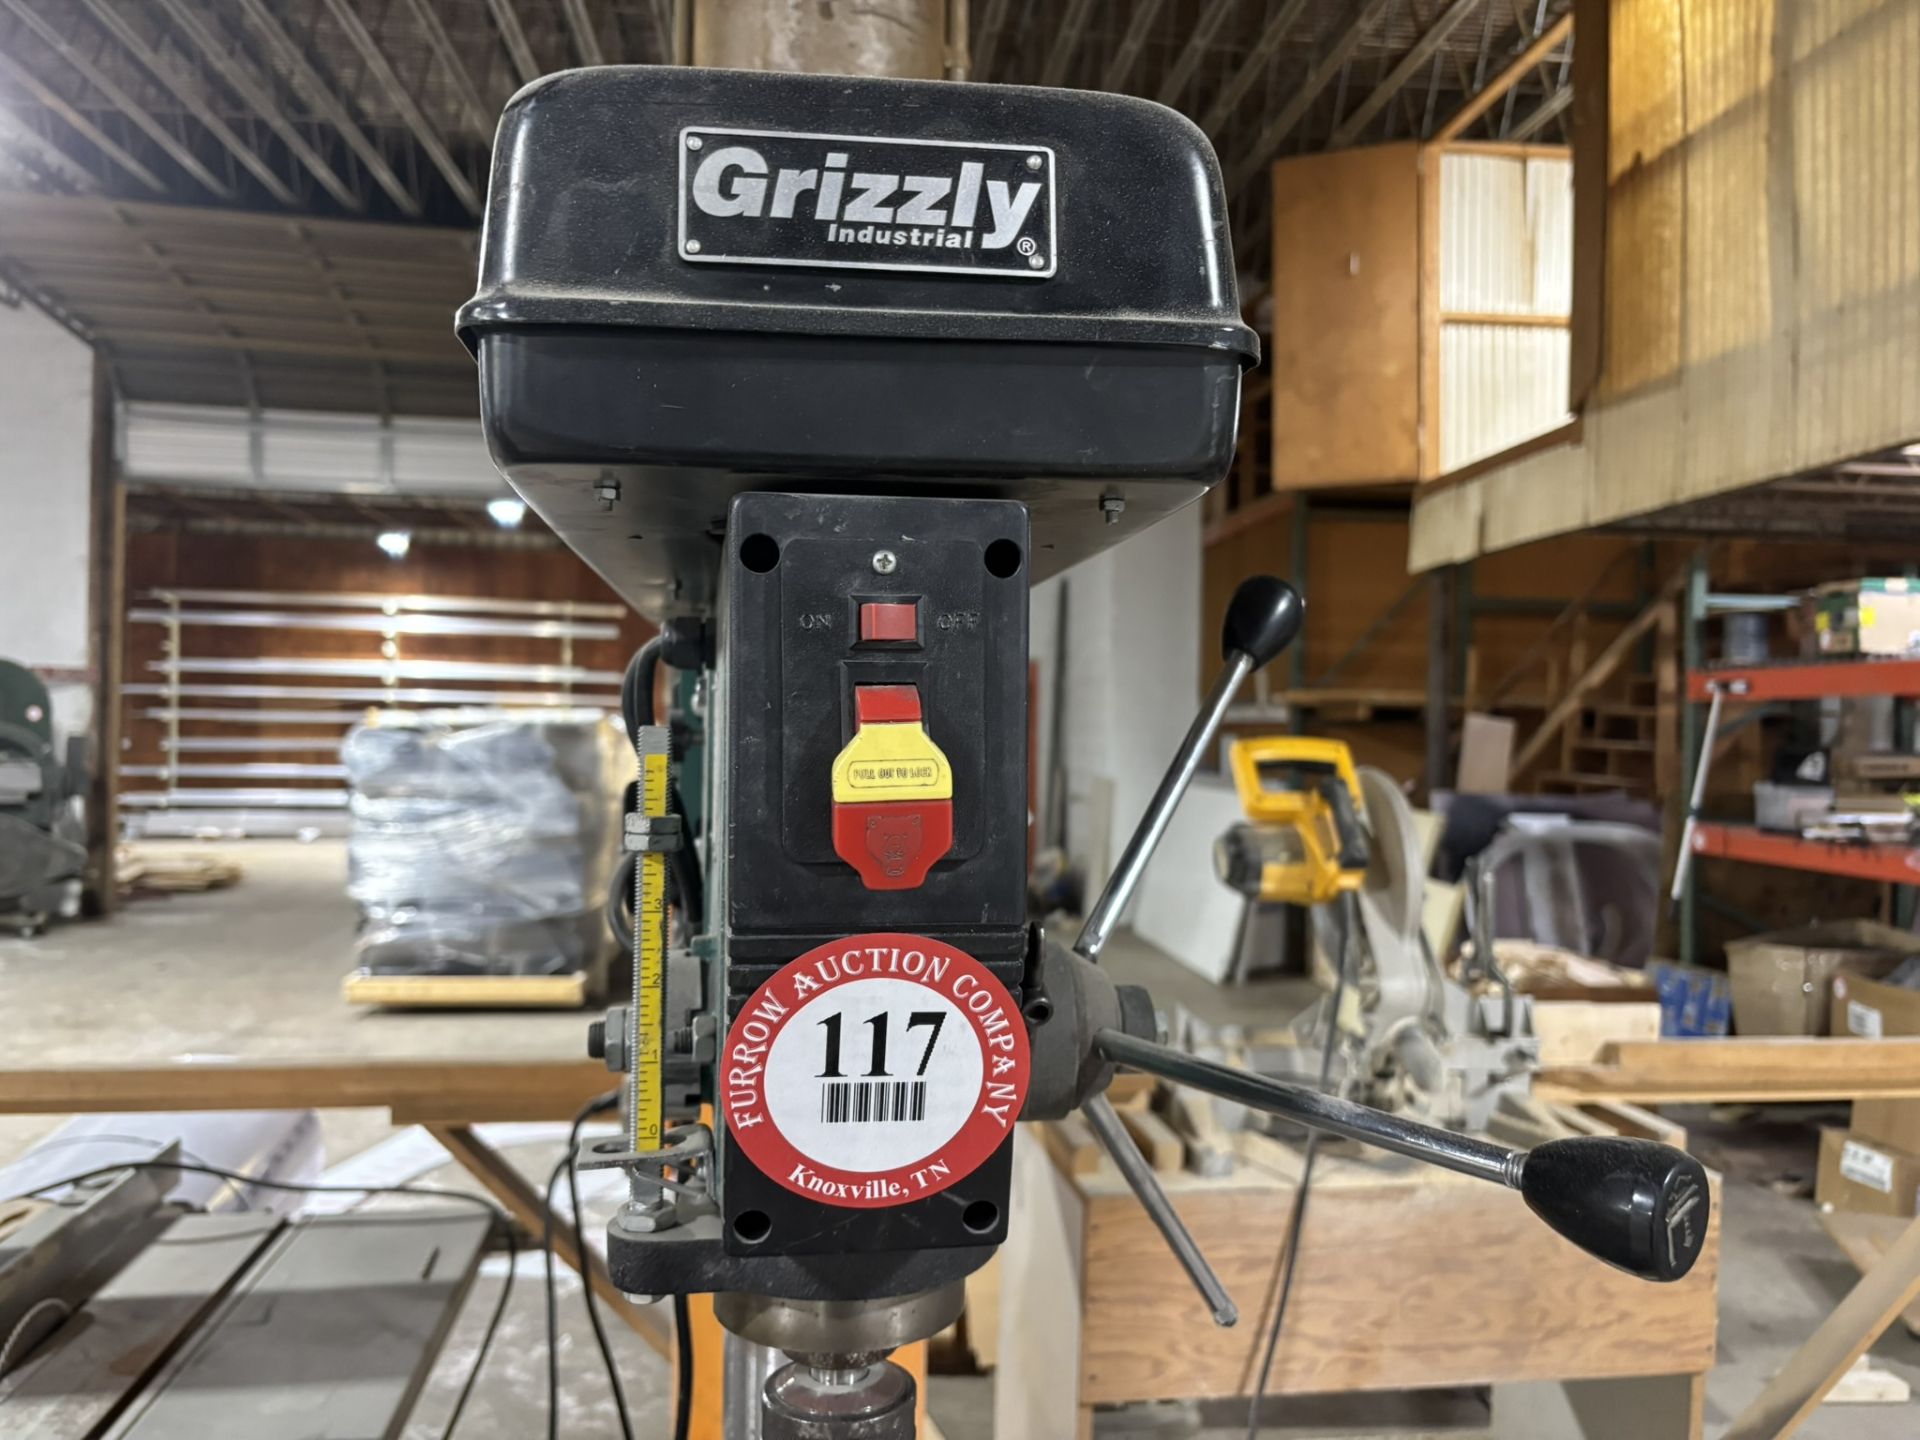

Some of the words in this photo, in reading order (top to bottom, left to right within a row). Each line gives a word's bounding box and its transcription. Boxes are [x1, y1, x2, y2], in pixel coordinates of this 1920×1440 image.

[692, 146, 1042, 250] Grizzly
[827, 223, 973, 249] Industrial
[799, 613, 832, 631] ON
[936, 612, 981, 631] OFF
[853, 768, 875, 780] PULL
[654, 898, 663, 910] 3
[652, 973, 661, 985] 2
[728, 987, 790, 1131] FURROW
[793, 947, 951, 1000] AUCTION
[951, 974, 1018, 1128] COMPANY
[814, 1010, 948, 1078] 117
[649, 1124, 658, 1136] 0
[786, 1162, 910, 1200] Knoxville,
[910, 1158, 951, 1189] TN
